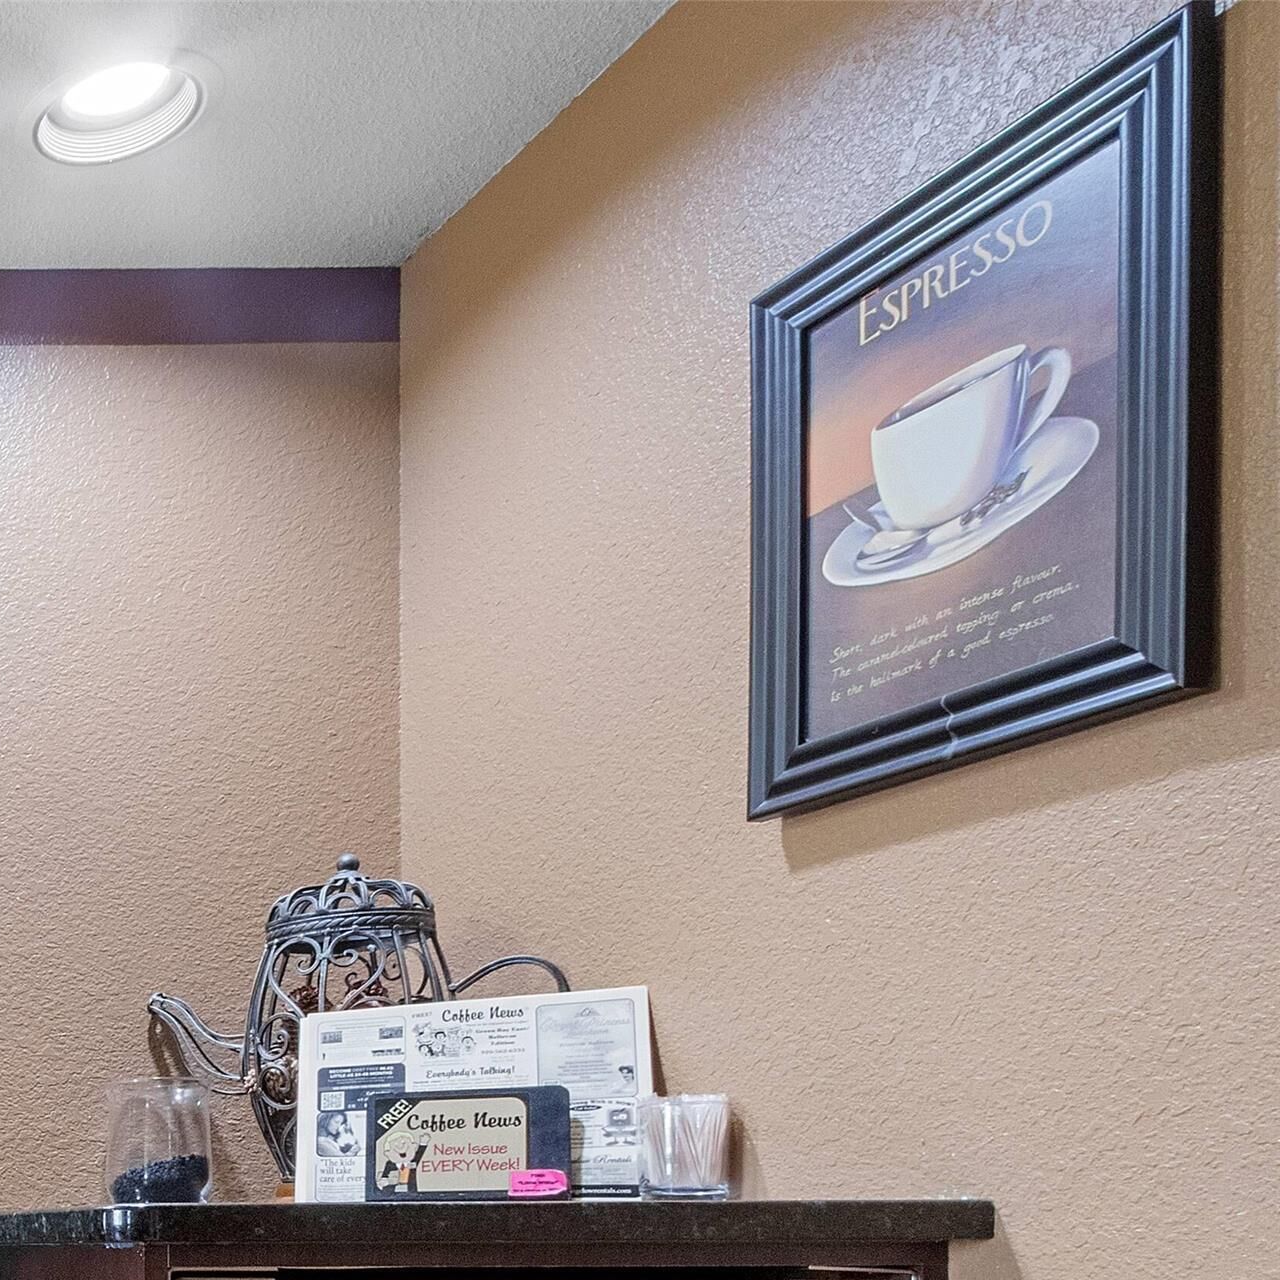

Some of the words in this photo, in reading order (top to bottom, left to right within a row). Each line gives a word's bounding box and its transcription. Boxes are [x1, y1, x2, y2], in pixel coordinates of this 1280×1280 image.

[858, 199, 1053, 346] ESPRESSO
[869, 629, 897, 646] dark
[905, 615, 929, 633] with
[935, 606, 953, 621] an
[959, 587, 1004, 610] intense
[1010, 563, 1062, 594] flavour.
[830, 666, 851, 685] The
[956, 610, 999, 633] topping
[1010, 599, 1026, 613] or
[1032, 582, 1080, 605] crema.
[846, 683, 864, 697] the
[870, 657, 922, 688] hallmark
[929, 649, 942, 669] of
[947, 649, 956, 658] a
[960, 631, 992, 659] good
[442, 1009, 485, 1023] Coffee
[490, 1006, 524, 1019] News
[426, 1068, 476, 1079] Everybody's
[480, 1065, 515, 1077] Talking!
[377, 1098, 413, 1130] FREE!
[406, 1113, 466, 1132] Coffee
[473, 1112, 522, 1128] News
[433, 1143, 465, 1155] New
[467, 1143, 508, 1155] Issue
[335, 1166, 352, 1174] take
[340, 1158, 355, 1167] kids
[421, 1158, 474, 1173] EVERY
[477, 1157, 520, 1171] Week!
